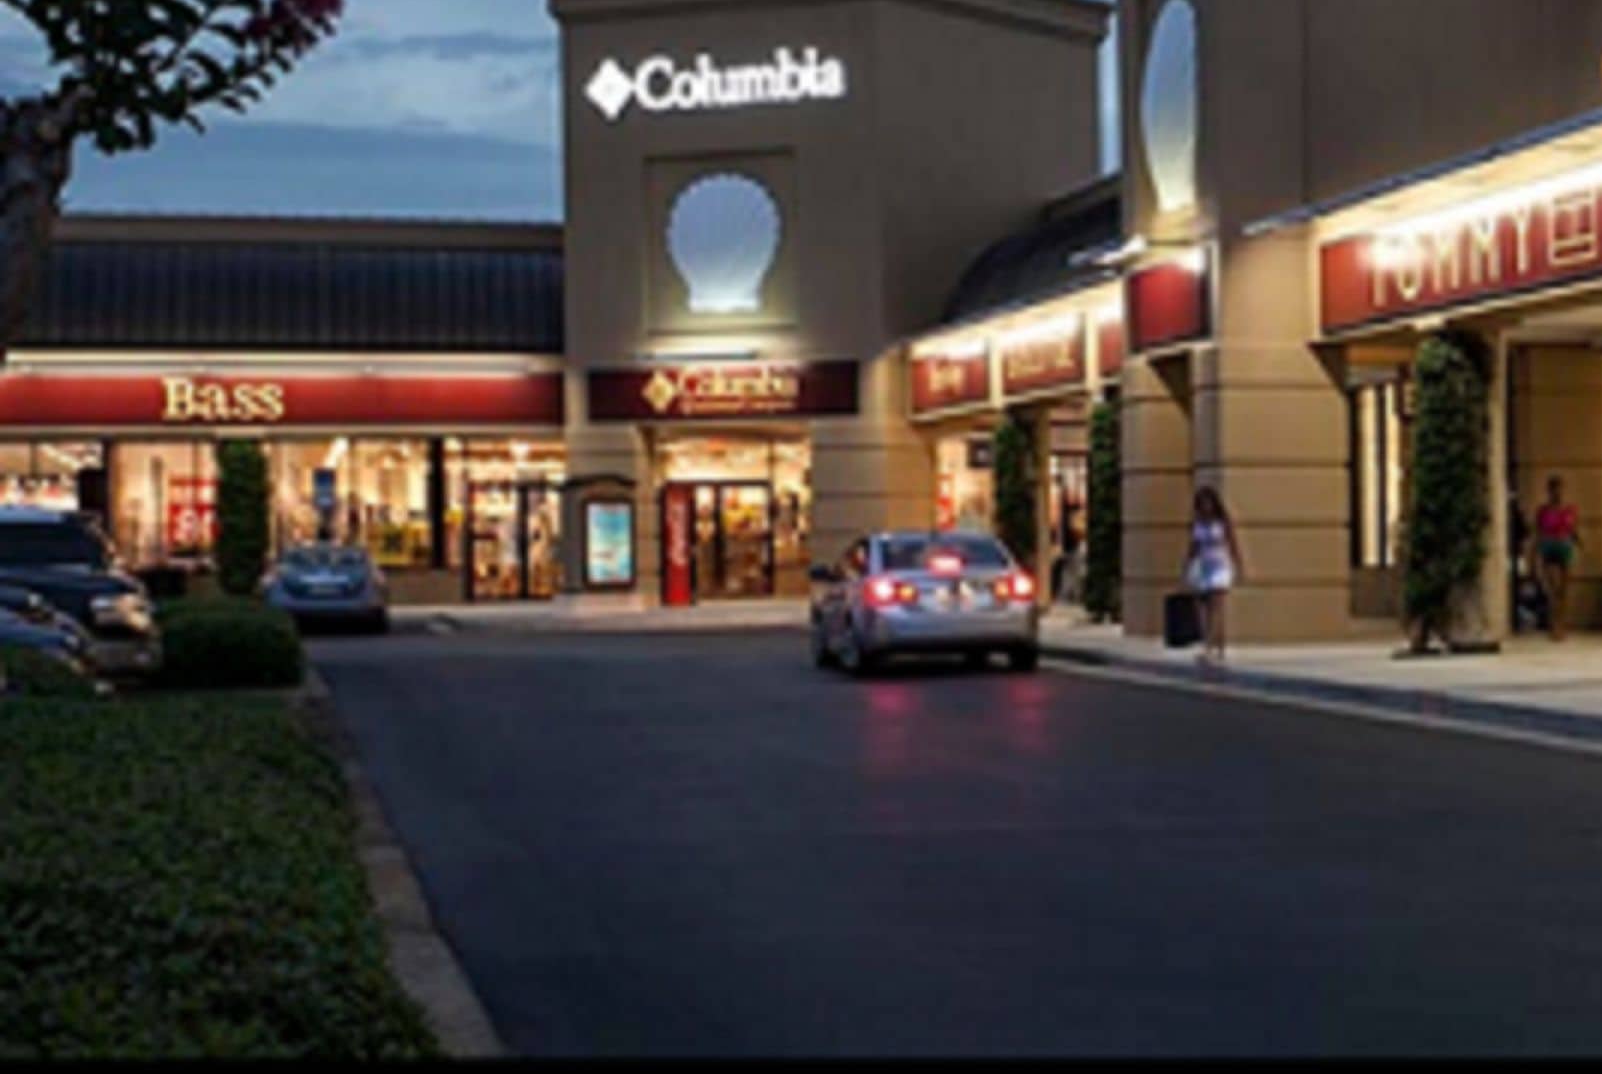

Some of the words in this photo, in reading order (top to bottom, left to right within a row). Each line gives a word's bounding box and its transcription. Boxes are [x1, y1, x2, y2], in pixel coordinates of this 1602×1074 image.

[634, 46, 845, 111] Columbia
[1363, 202, 1535, 307] TOMMY
[161, 375, 286, 421] Bass
